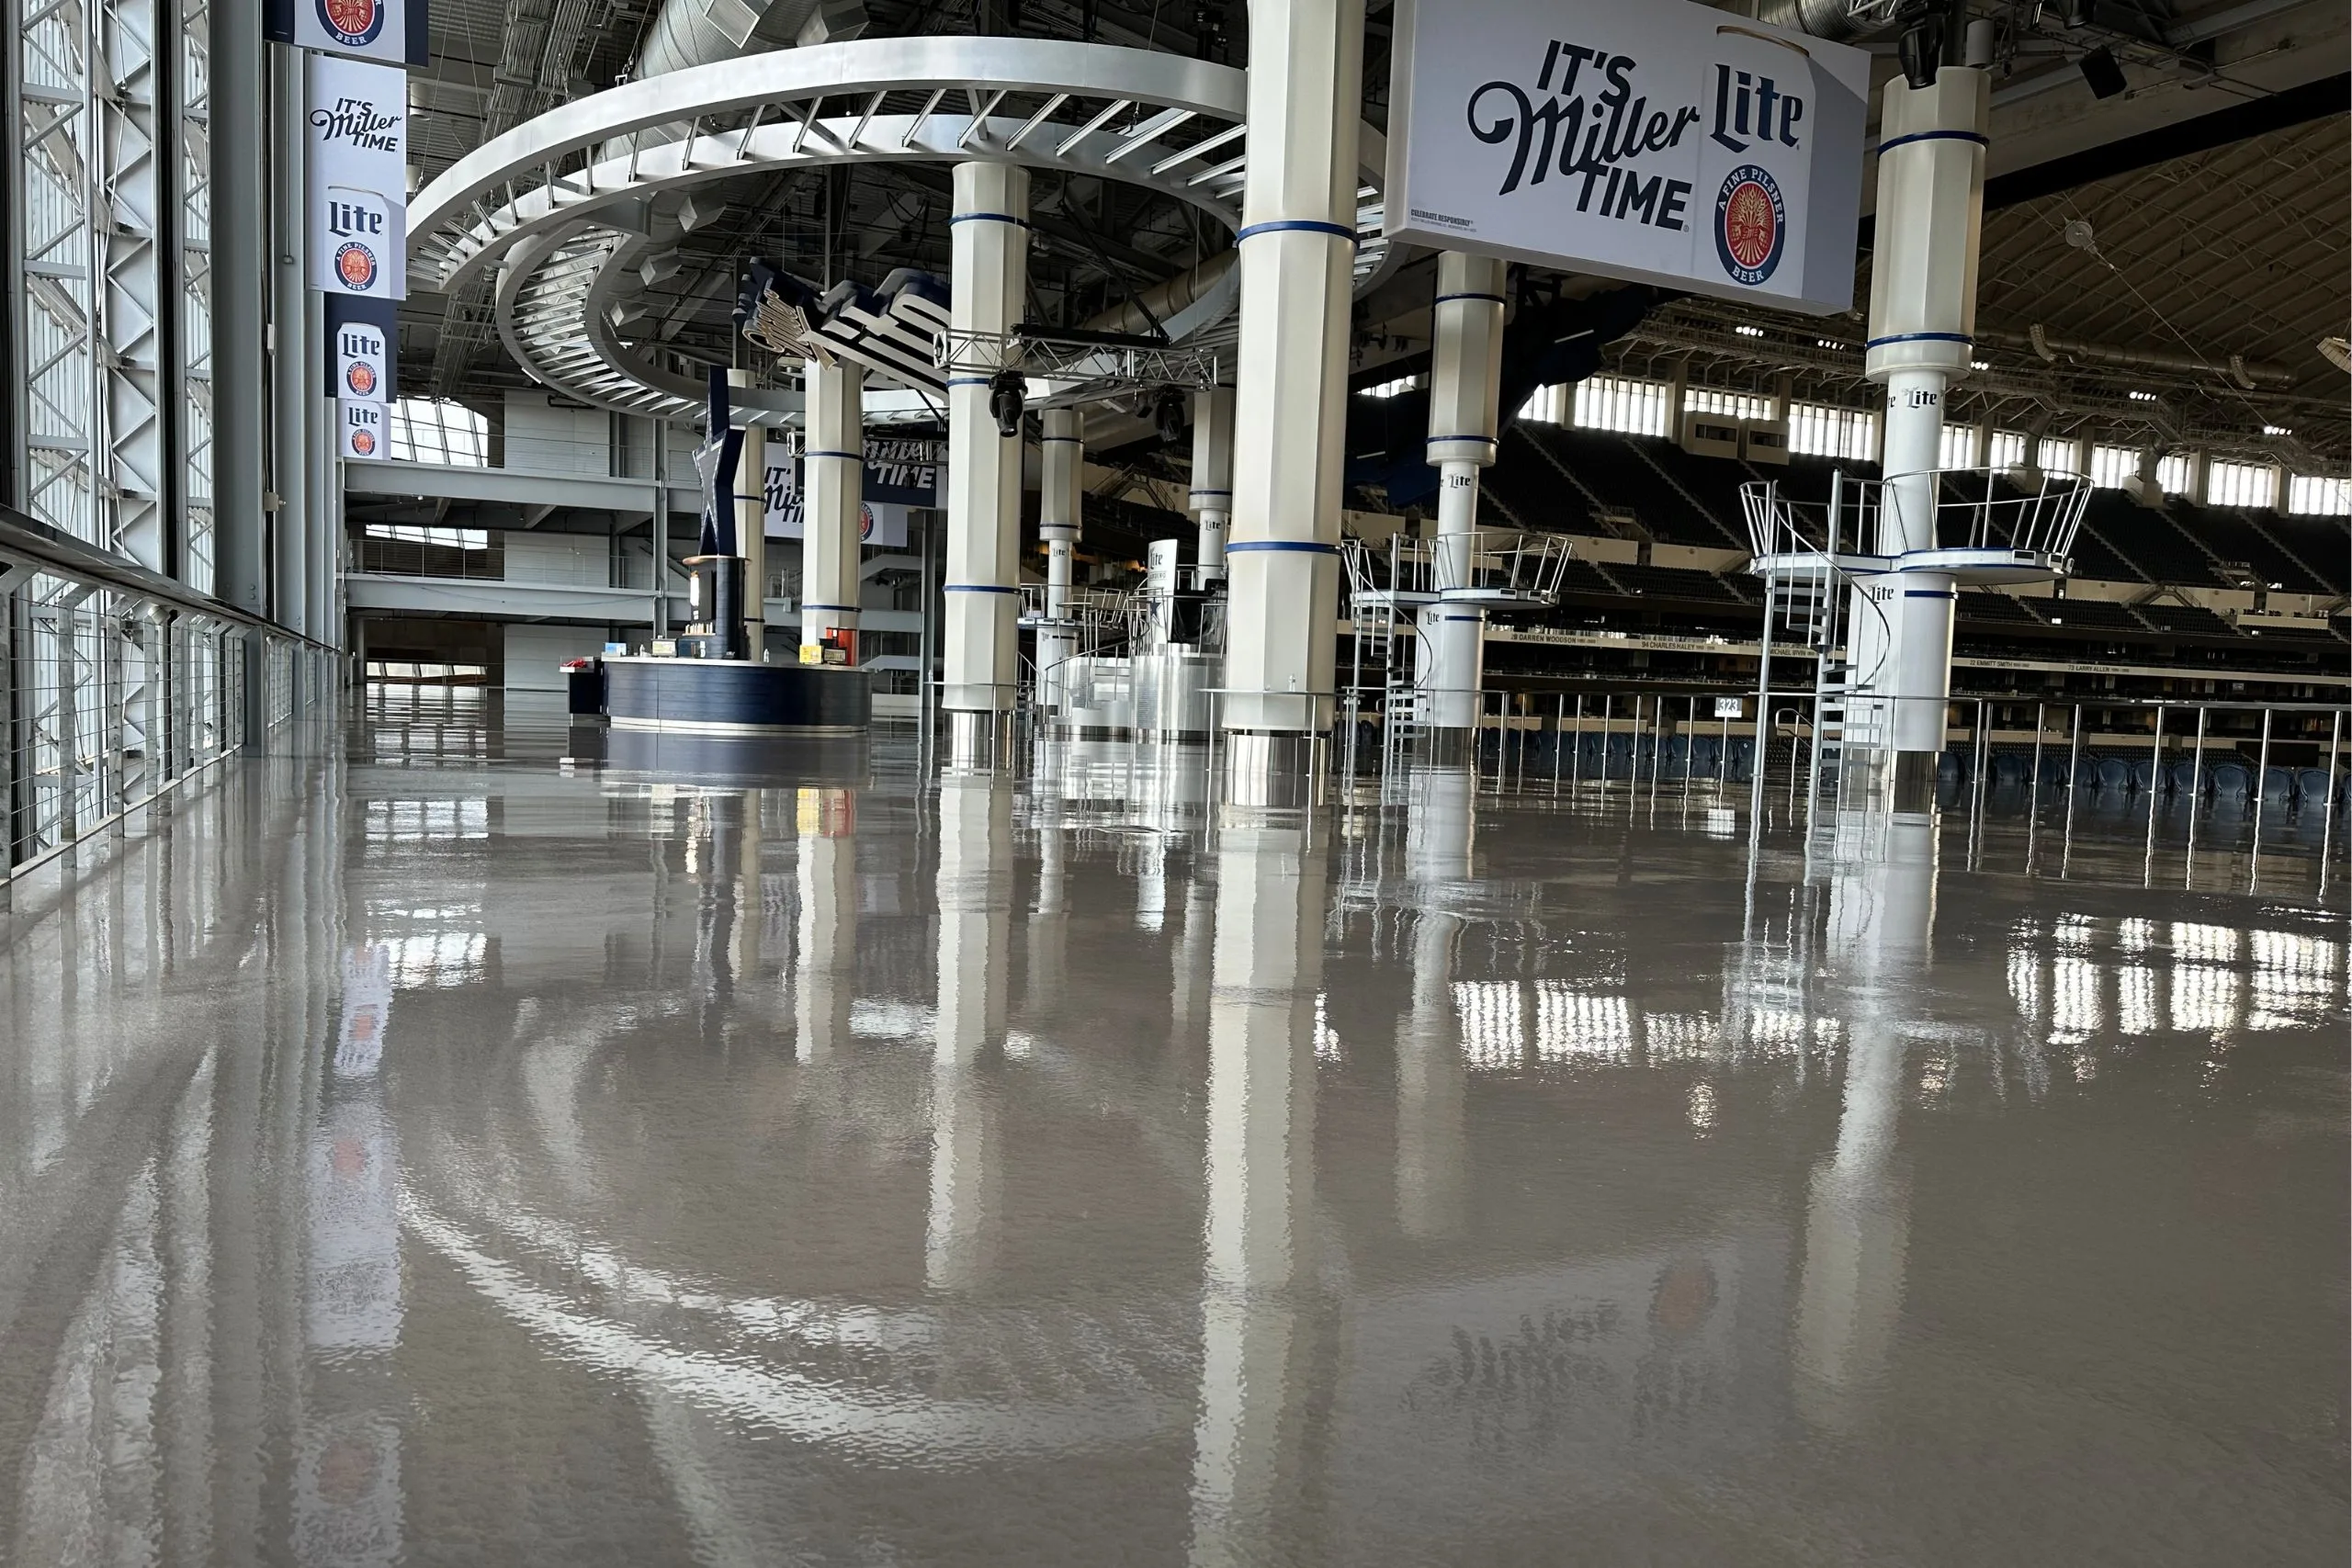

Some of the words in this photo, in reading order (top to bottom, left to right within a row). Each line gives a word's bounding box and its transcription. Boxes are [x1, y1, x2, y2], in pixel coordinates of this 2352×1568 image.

[335, 32, 367, 45] BEER
[1536, 39, 1636, 106] IT'S
[335, 98, 373, 119] IT'S
[1710, 63, 1803, 153] Lite
[310, 109, 402, 141] Miller
[353, 132, 398, 152] TIME
[1467, 80, 1700, 197] Miller
[1577, 164, 1691, 231] TIME
[1718, 201, 1726, 211] A
[1723, 169, 1747, 196] FINE
[1751, 168, 1783, 223] PILSNER
[328, 200, 382, 237] Lite
[1411, 209, 1438, 221] CELEBRATE
[1732, 265, 1764, 282] BEER
[342, 333, 380, 358] Lite
[1906, 389, 1938, 410] Lite
[348, 407, 378, 426] Lite
[1450, 475, 1471, 489] Lite
[1871, 586, 1894, 604] Lite
[1519, 634, 1544, 642] DARREN
[1546, 636, 1577, 644] WOODSON
[1719, 698, 1738, 713] 323
